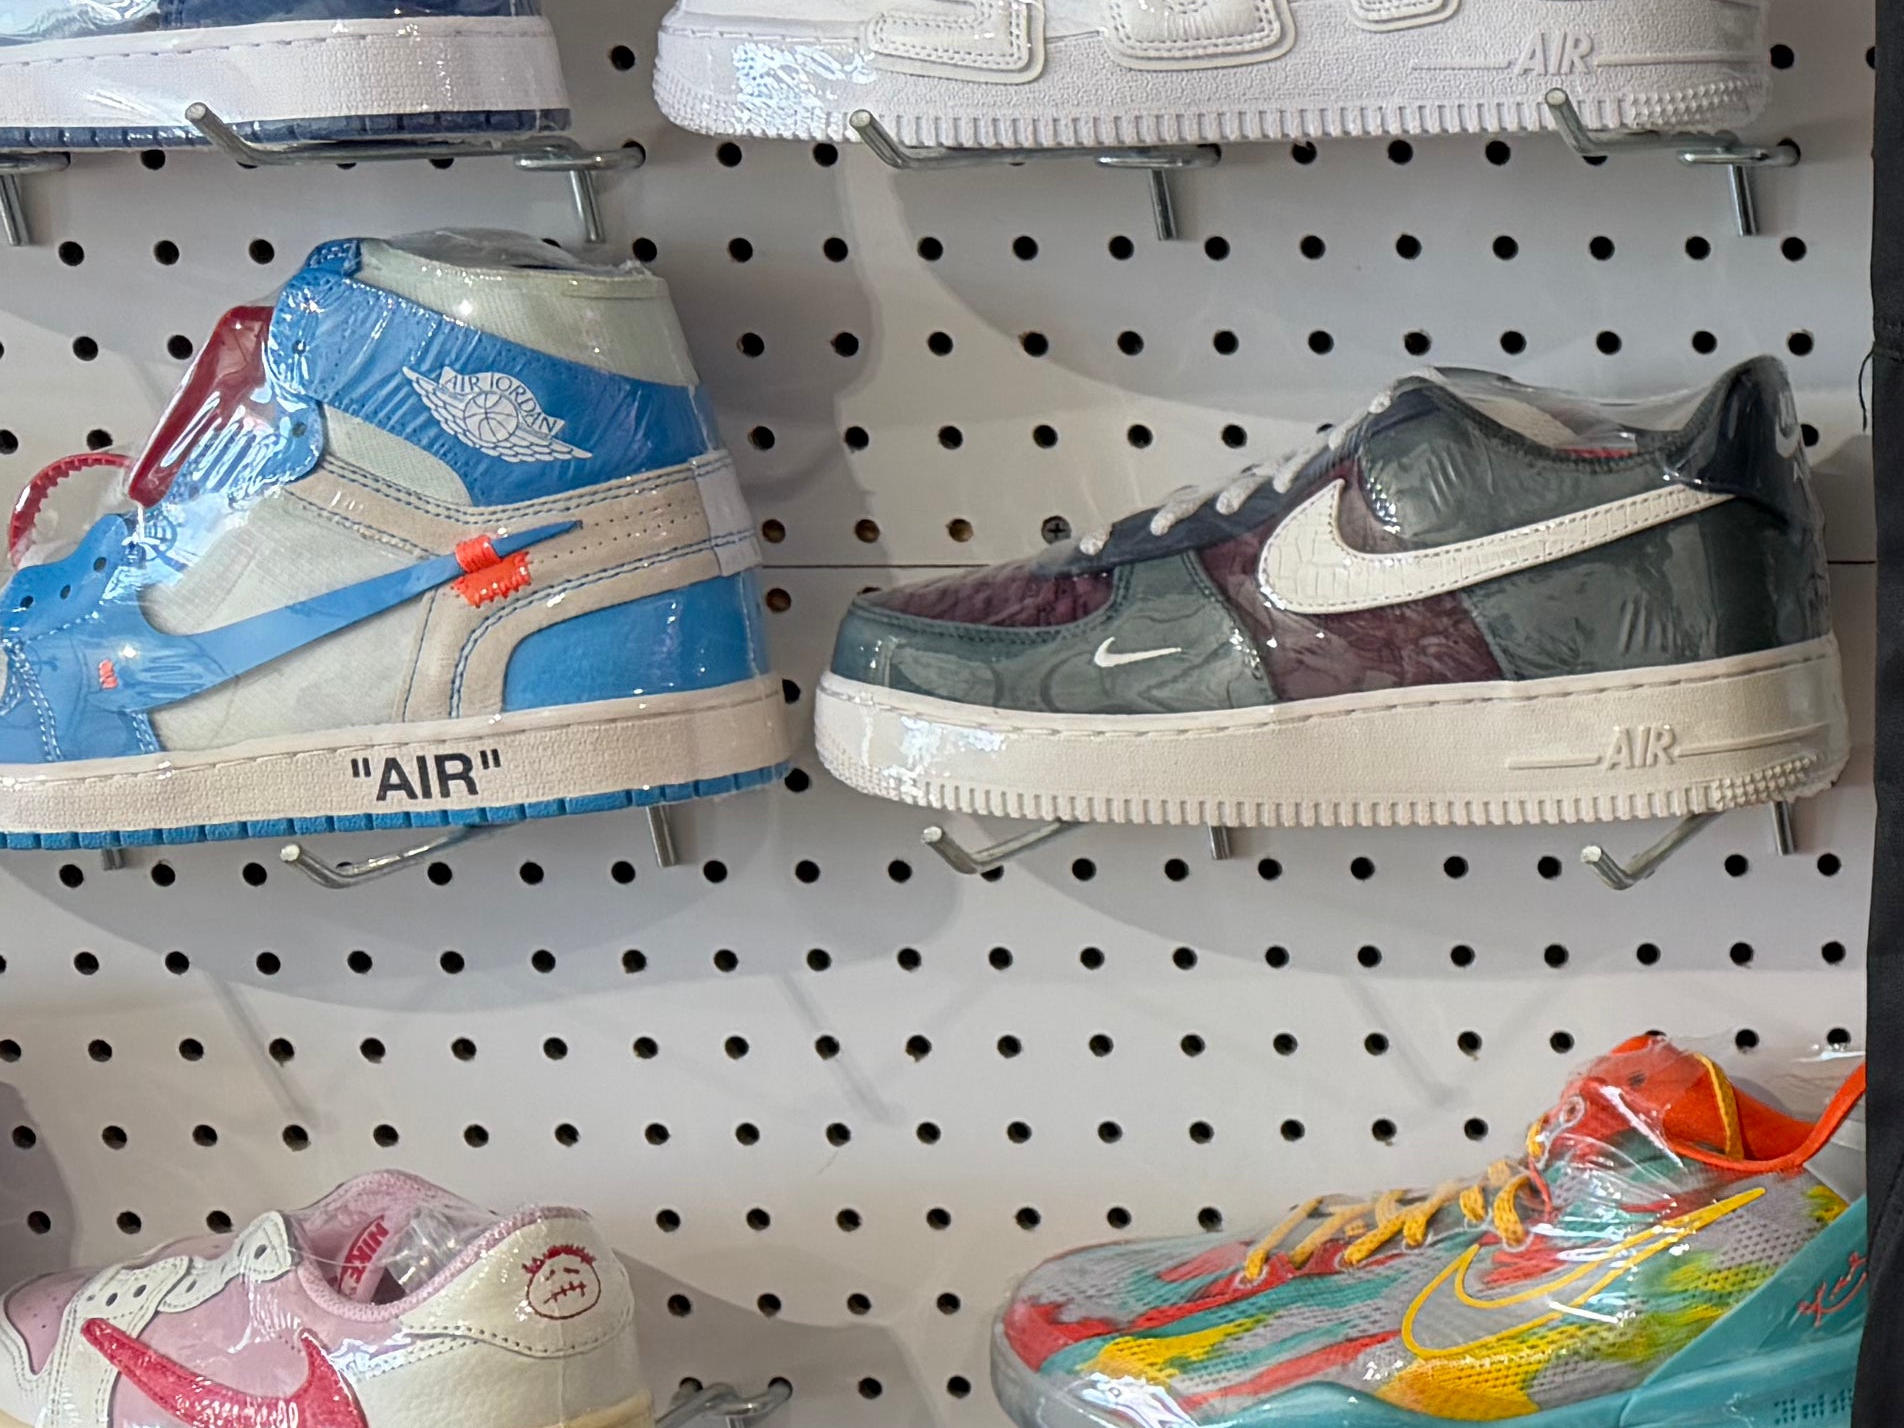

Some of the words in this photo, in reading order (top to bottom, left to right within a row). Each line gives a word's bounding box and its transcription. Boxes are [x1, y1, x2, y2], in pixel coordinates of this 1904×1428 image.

[1514, 26, 1594, 76] AIR
[440, 373, 482, 392] AIR
[1603, 723, 1677, 771] AIR
[351, 748, 502, 801] "AIR"
